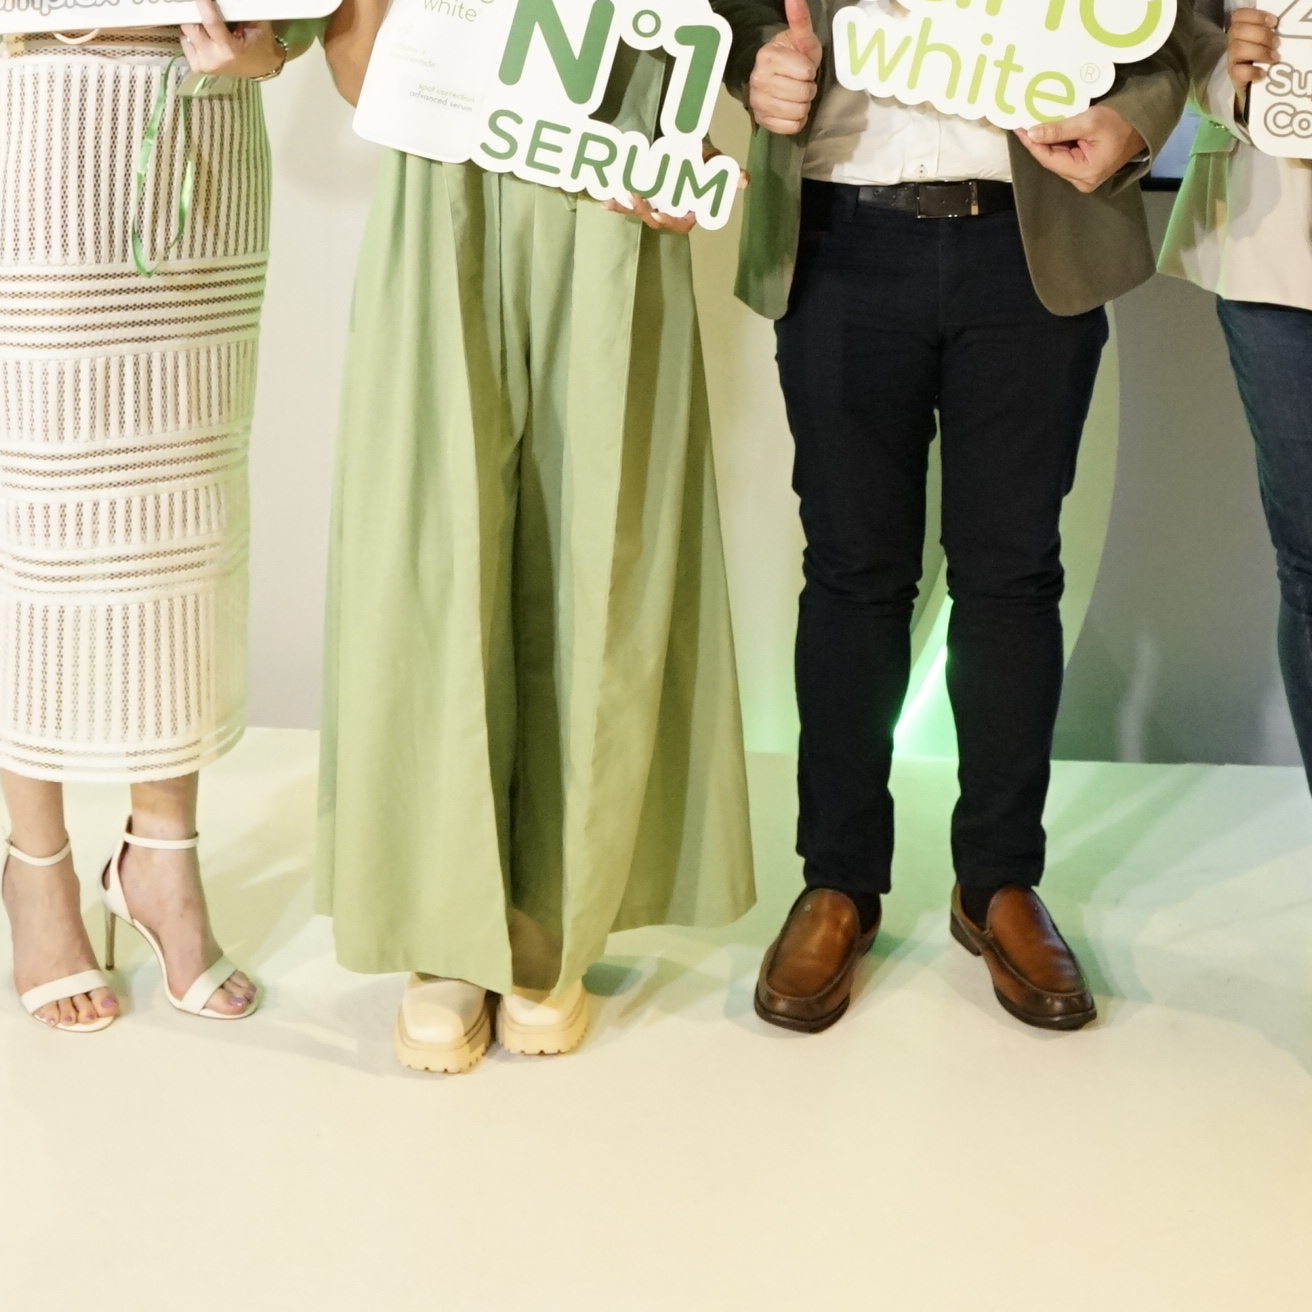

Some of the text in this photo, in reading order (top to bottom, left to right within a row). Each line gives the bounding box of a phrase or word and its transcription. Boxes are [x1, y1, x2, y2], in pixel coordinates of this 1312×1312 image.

[410, 91, 472, 112] advanced serum
[418, 83, 475, 103] spot correction
[480, 110, 728, 218] SERUM
